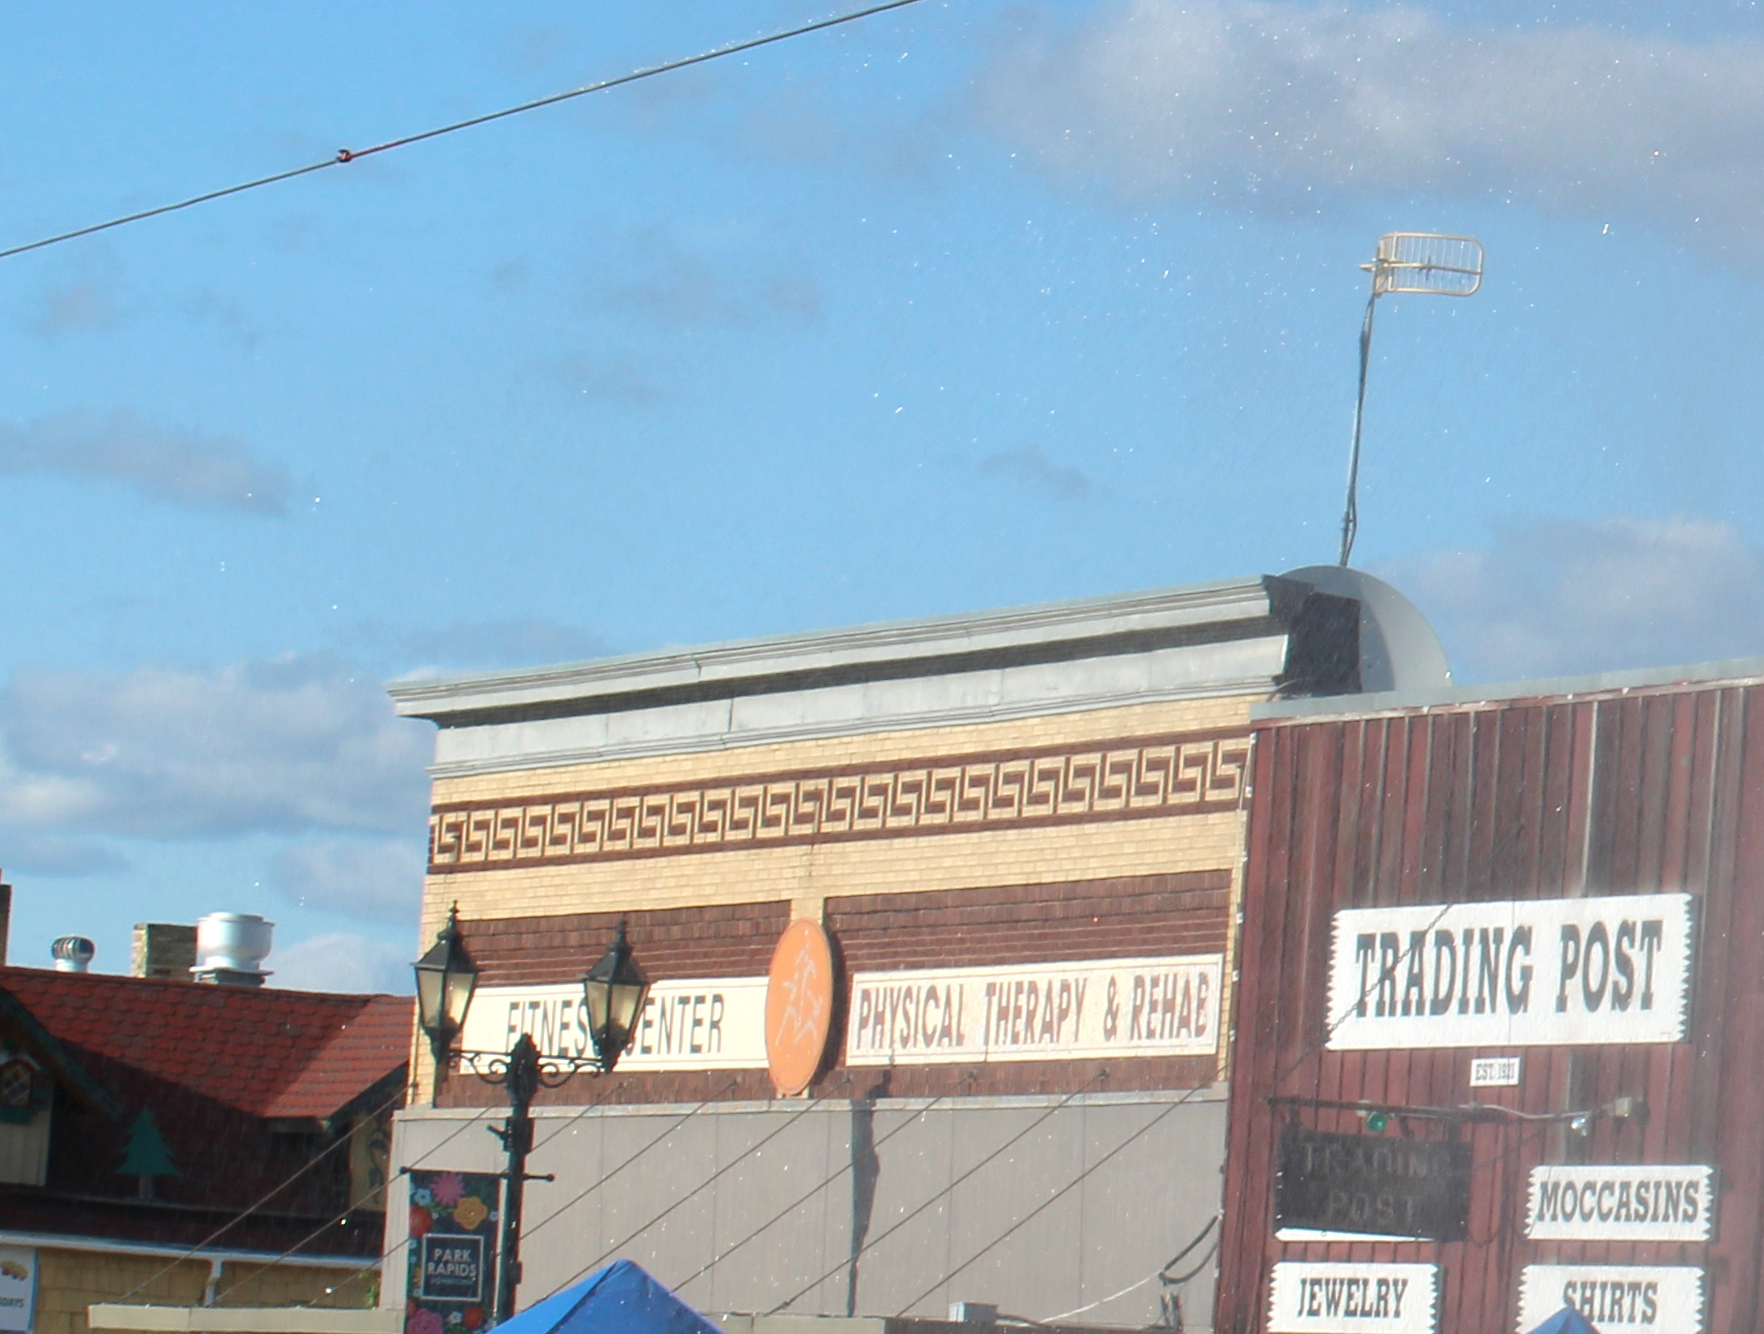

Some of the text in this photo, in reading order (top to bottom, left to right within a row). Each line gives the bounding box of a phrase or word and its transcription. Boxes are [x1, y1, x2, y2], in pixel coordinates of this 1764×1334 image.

[1356, 919, 1663, 1018] TRADING POST
[857, 970, 1210, 1050] PHYSICAL THERAPY & REHAB
[1537, 1179, 1700, 1224] MOCCASINS
[427, 1261, 477, 1277] RAPIDS
[434, 1247, 472, 1263] PARK
[1297, 1278, 1409, 1320] JEWELRY
[1563, 1279, 1658, 1324] SHIRTS
